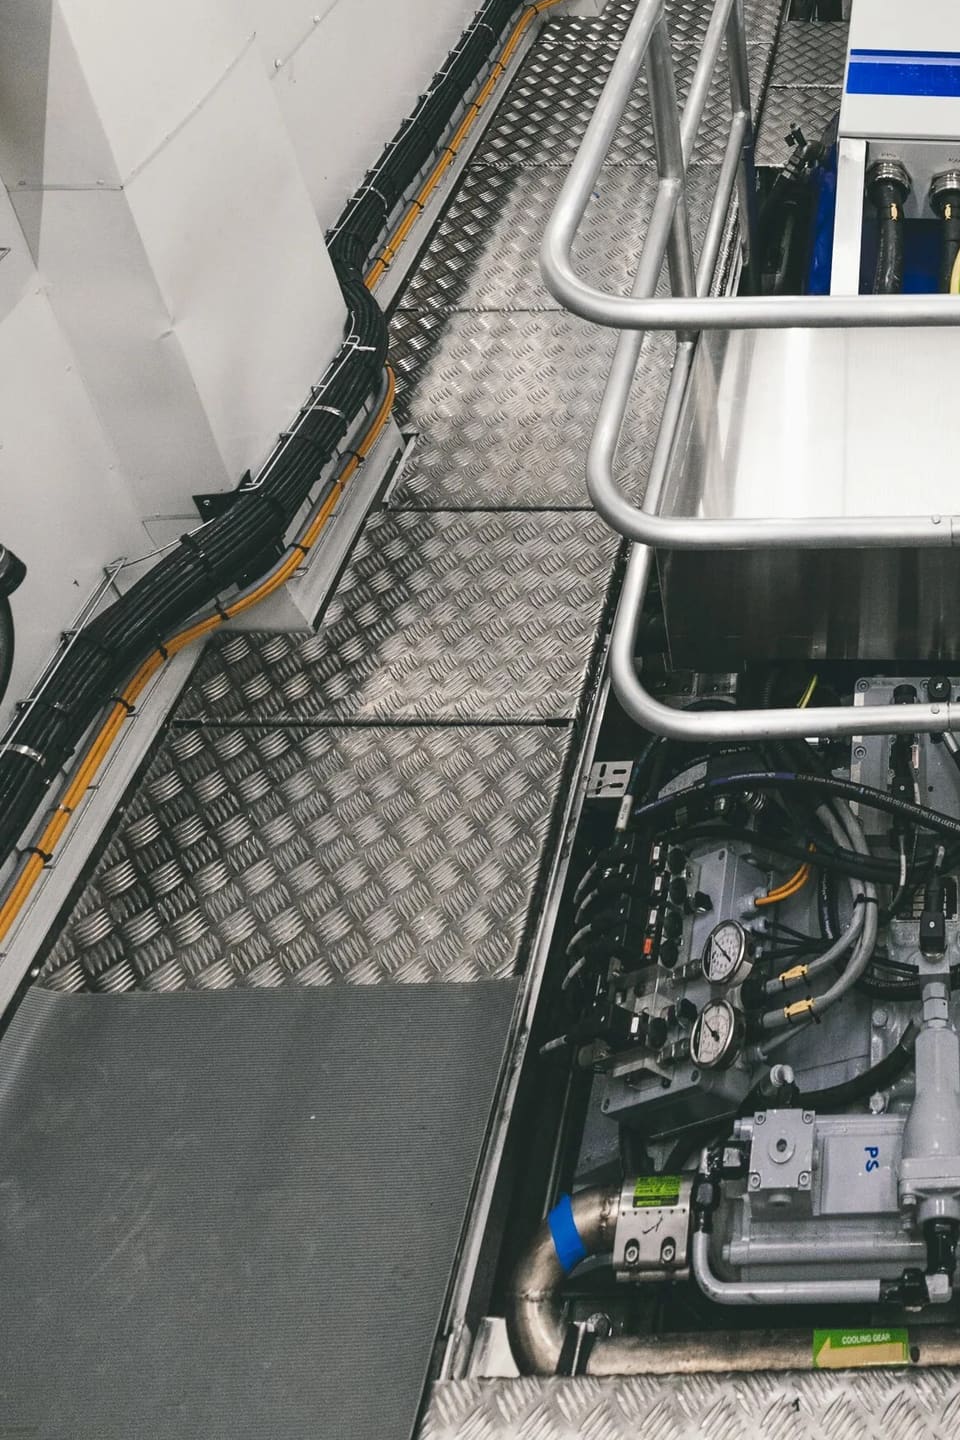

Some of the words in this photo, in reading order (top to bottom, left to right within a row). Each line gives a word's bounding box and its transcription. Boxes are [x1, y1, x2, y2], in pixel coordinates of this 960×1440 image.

[864, 1146, 879, 1172] PS
[841, 1334, 872, 1345] COOLING
[872, 1333, 891, 1342] GEAR
